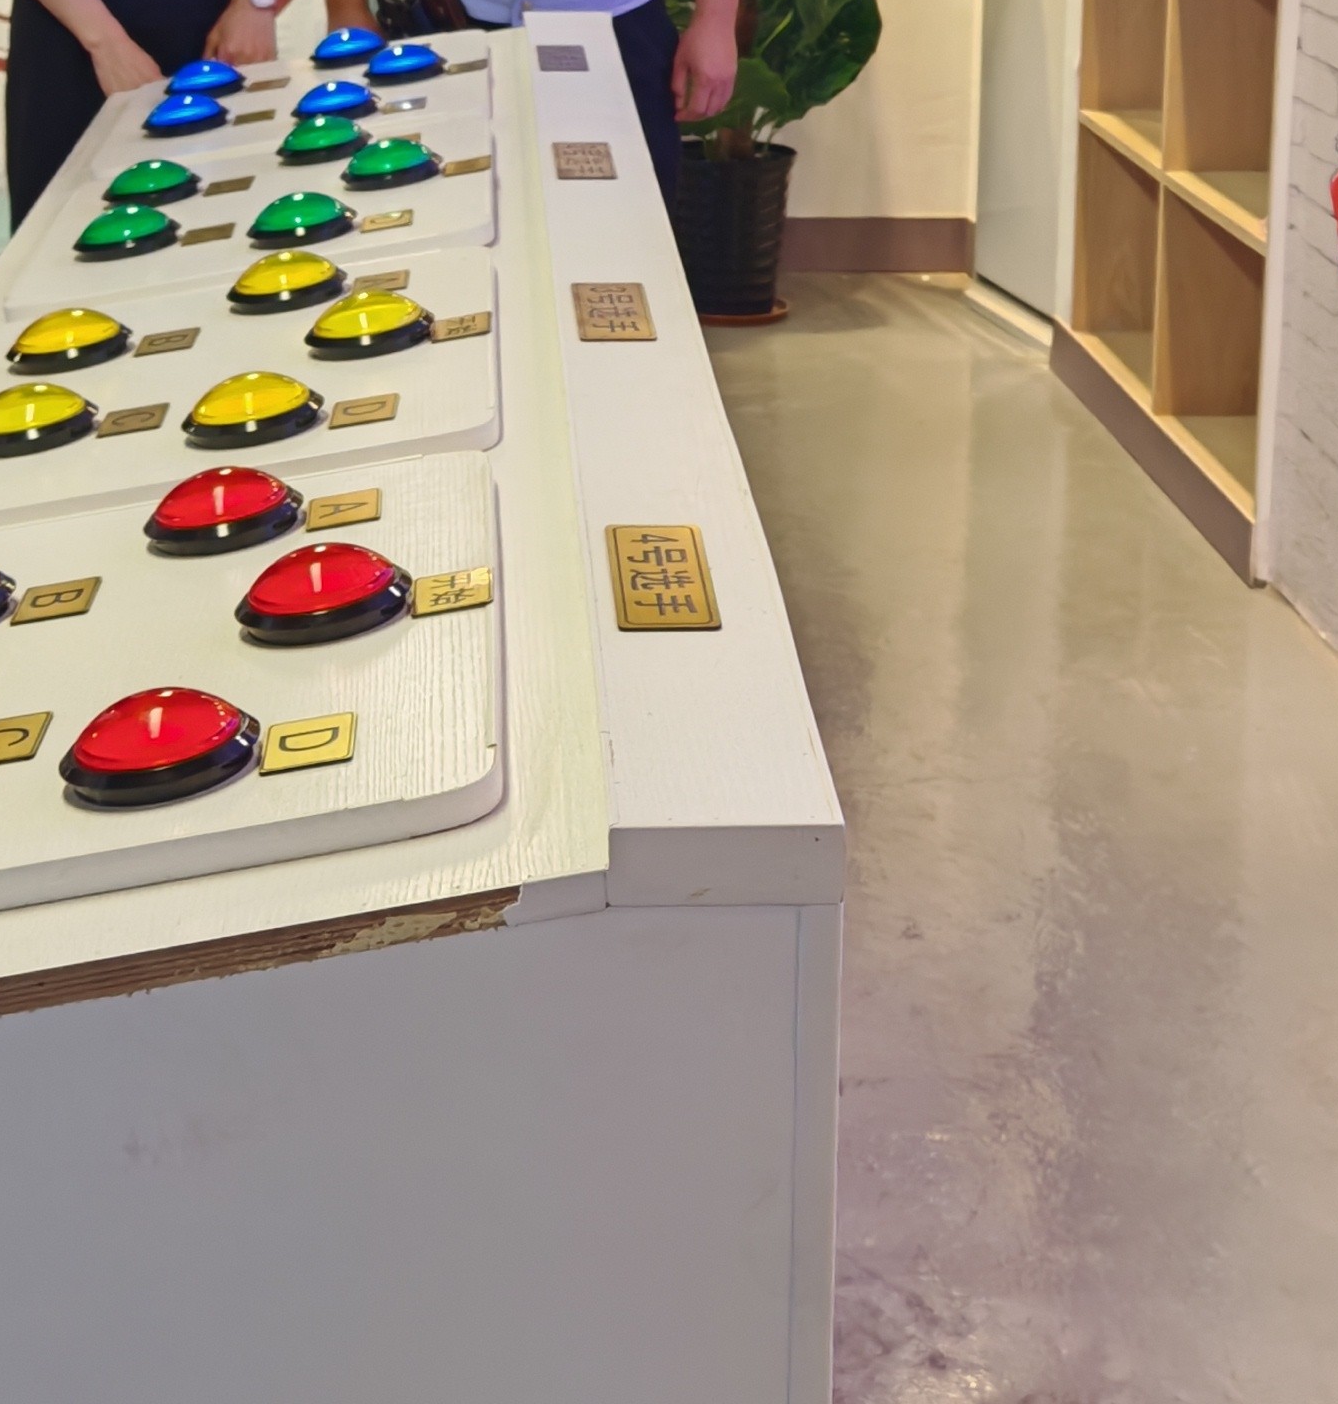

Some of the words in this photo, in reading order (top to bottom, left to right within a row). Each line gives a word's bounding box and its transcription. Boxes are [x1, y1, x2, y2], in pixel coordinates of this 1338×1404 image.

[318, 501, 370, 520] A
[626, 533, 698, 617] 4号选手
[29, 588, 85, 609] B
[278, 725, 341, 753] D
